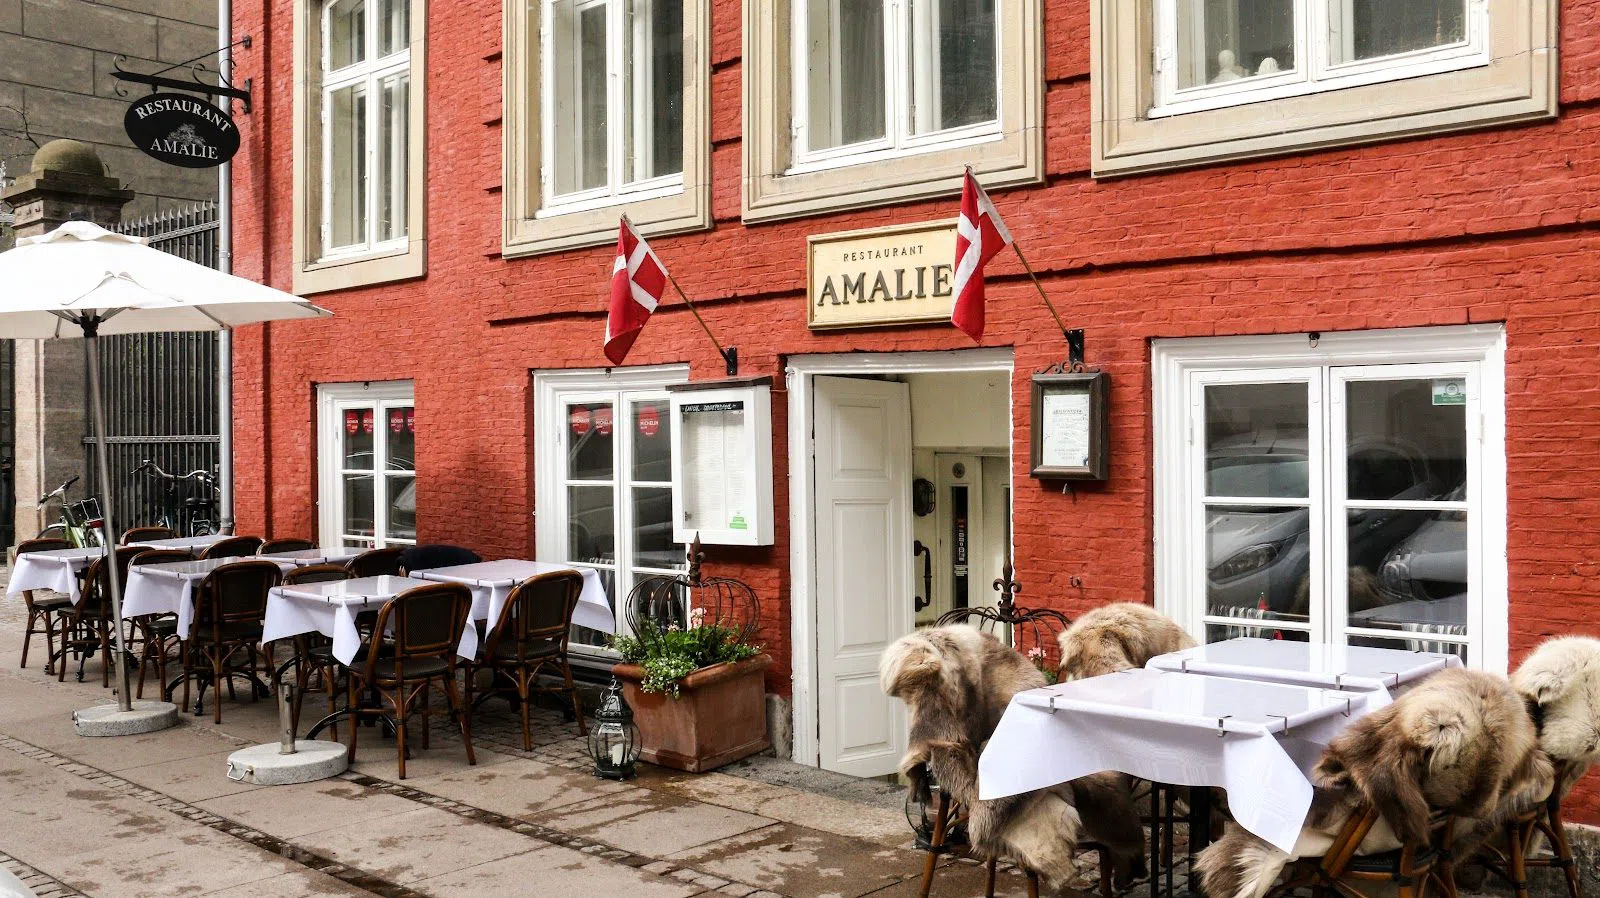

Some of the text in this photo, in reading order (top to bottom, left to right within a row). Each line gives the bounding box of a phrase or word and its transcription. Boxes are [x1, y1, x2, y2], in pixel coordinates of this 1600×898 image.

[135, 98, 231, 132] RESTAURANT
[150, 138, 218, 160] AMALIE
[843, 245, 924, 262] RESTAURANT
[817, 264, 953, 306] AMALIE
